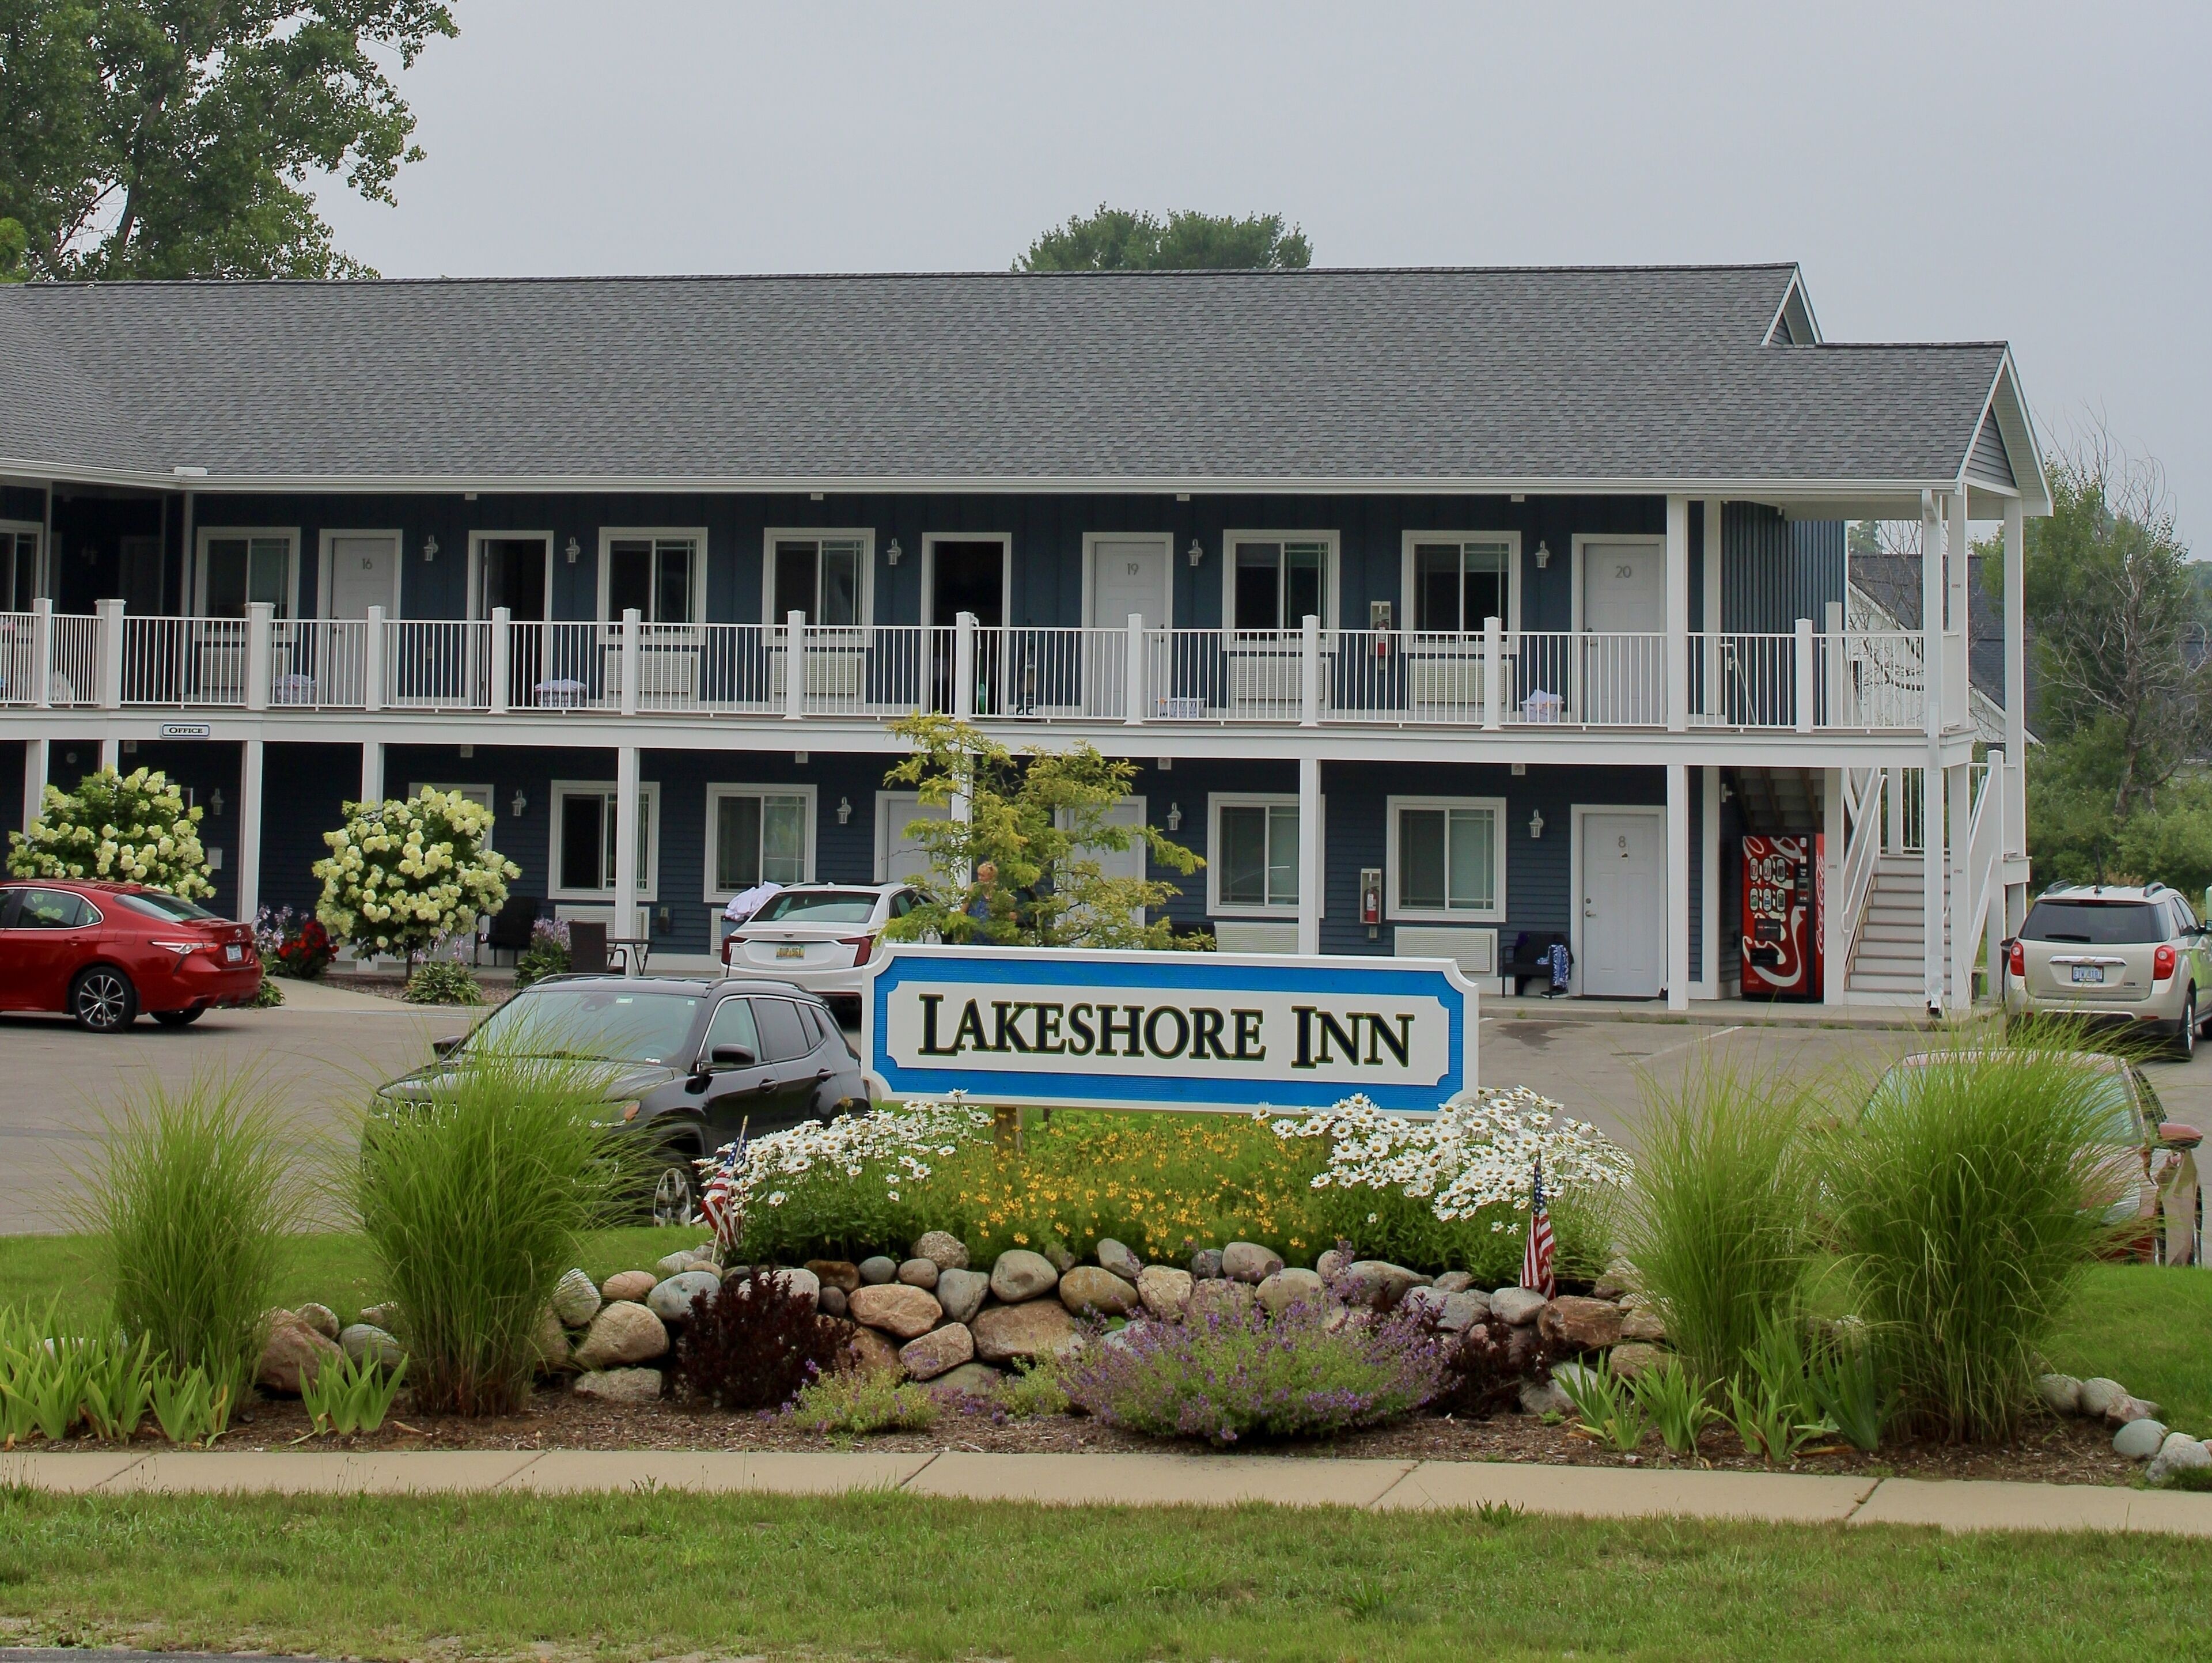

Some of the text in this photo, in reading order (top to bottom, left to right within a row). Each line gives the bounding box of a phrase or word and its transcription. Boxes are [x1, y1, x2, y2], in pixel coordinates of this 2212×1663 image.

[362, 558, 373, 570] 16
[1127, 563, 1139, 575] 19
[1615, 566, 1631, 578] 20
[1618, 835, 1626, 848] 8
[918, 993, 1415, 1069] LAKESHORE INN
